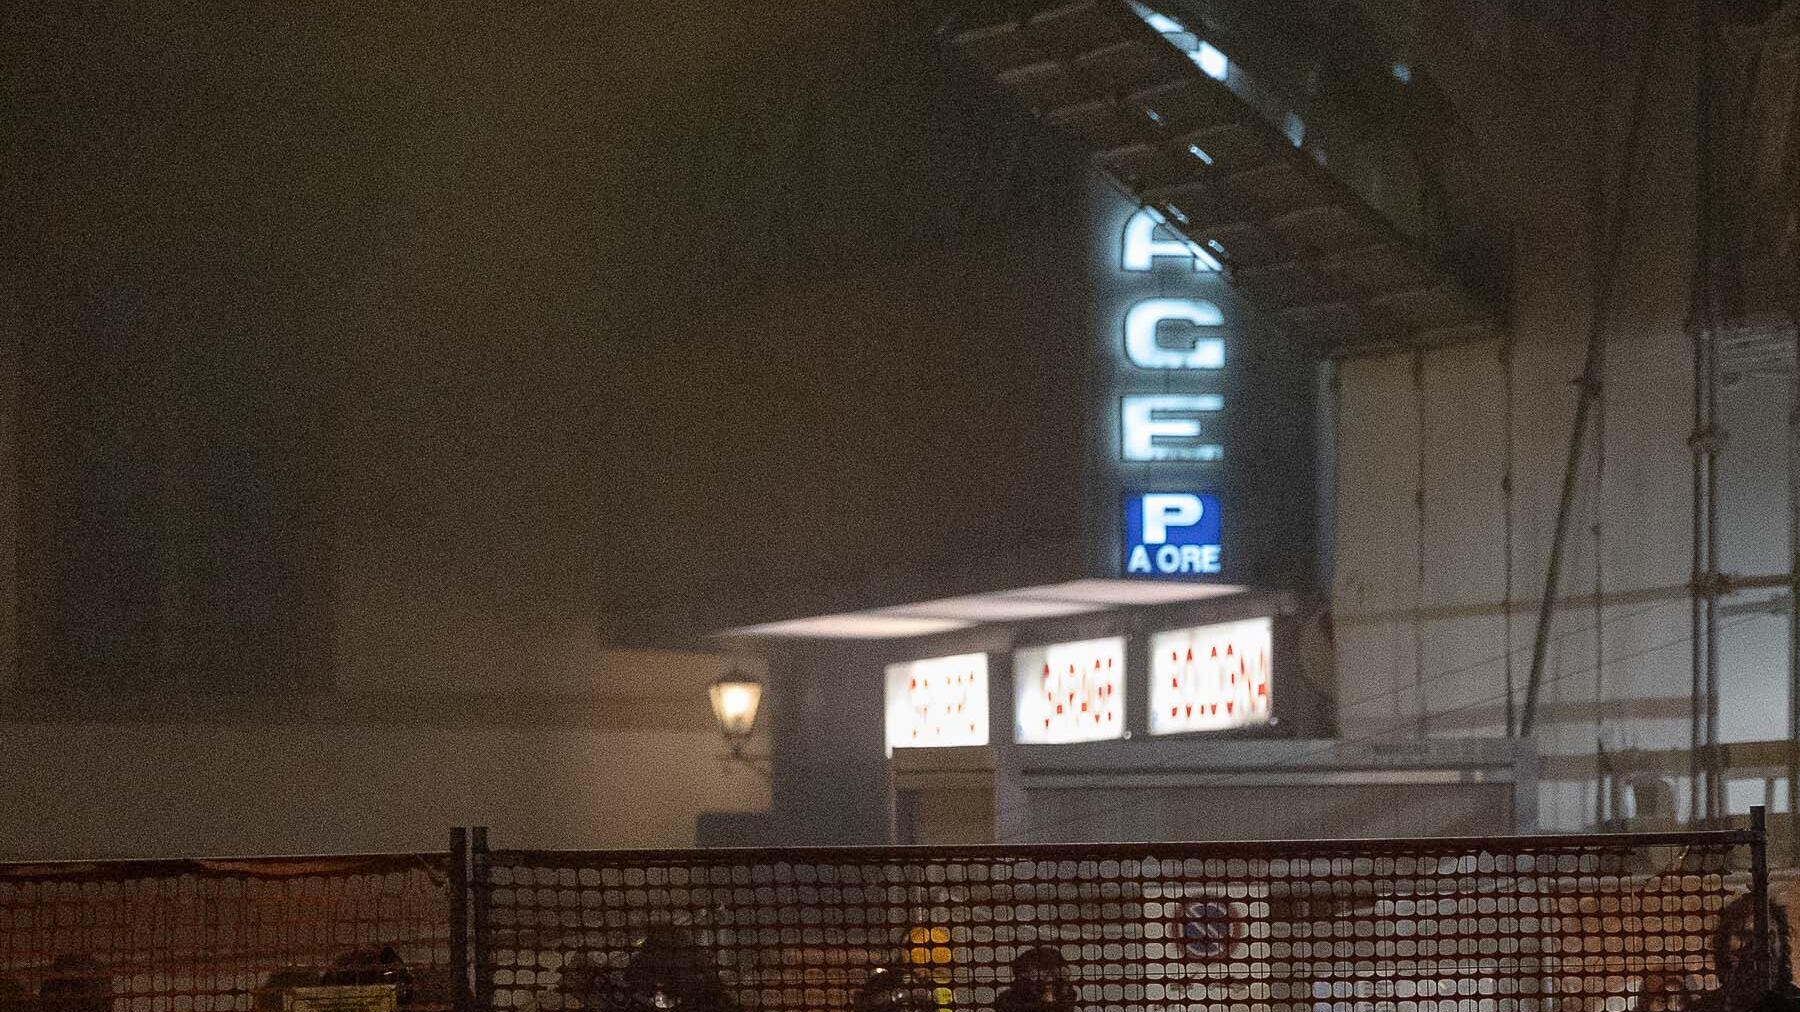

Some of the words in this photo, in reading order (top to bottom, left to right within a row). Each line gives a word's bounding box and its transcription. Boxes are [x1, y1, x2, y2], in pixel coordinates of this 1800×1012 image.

[1142, 493, 1203, 545] P
[1128, 545, 1154, 573] A
[1157, 544, 1222, 573] ORE
